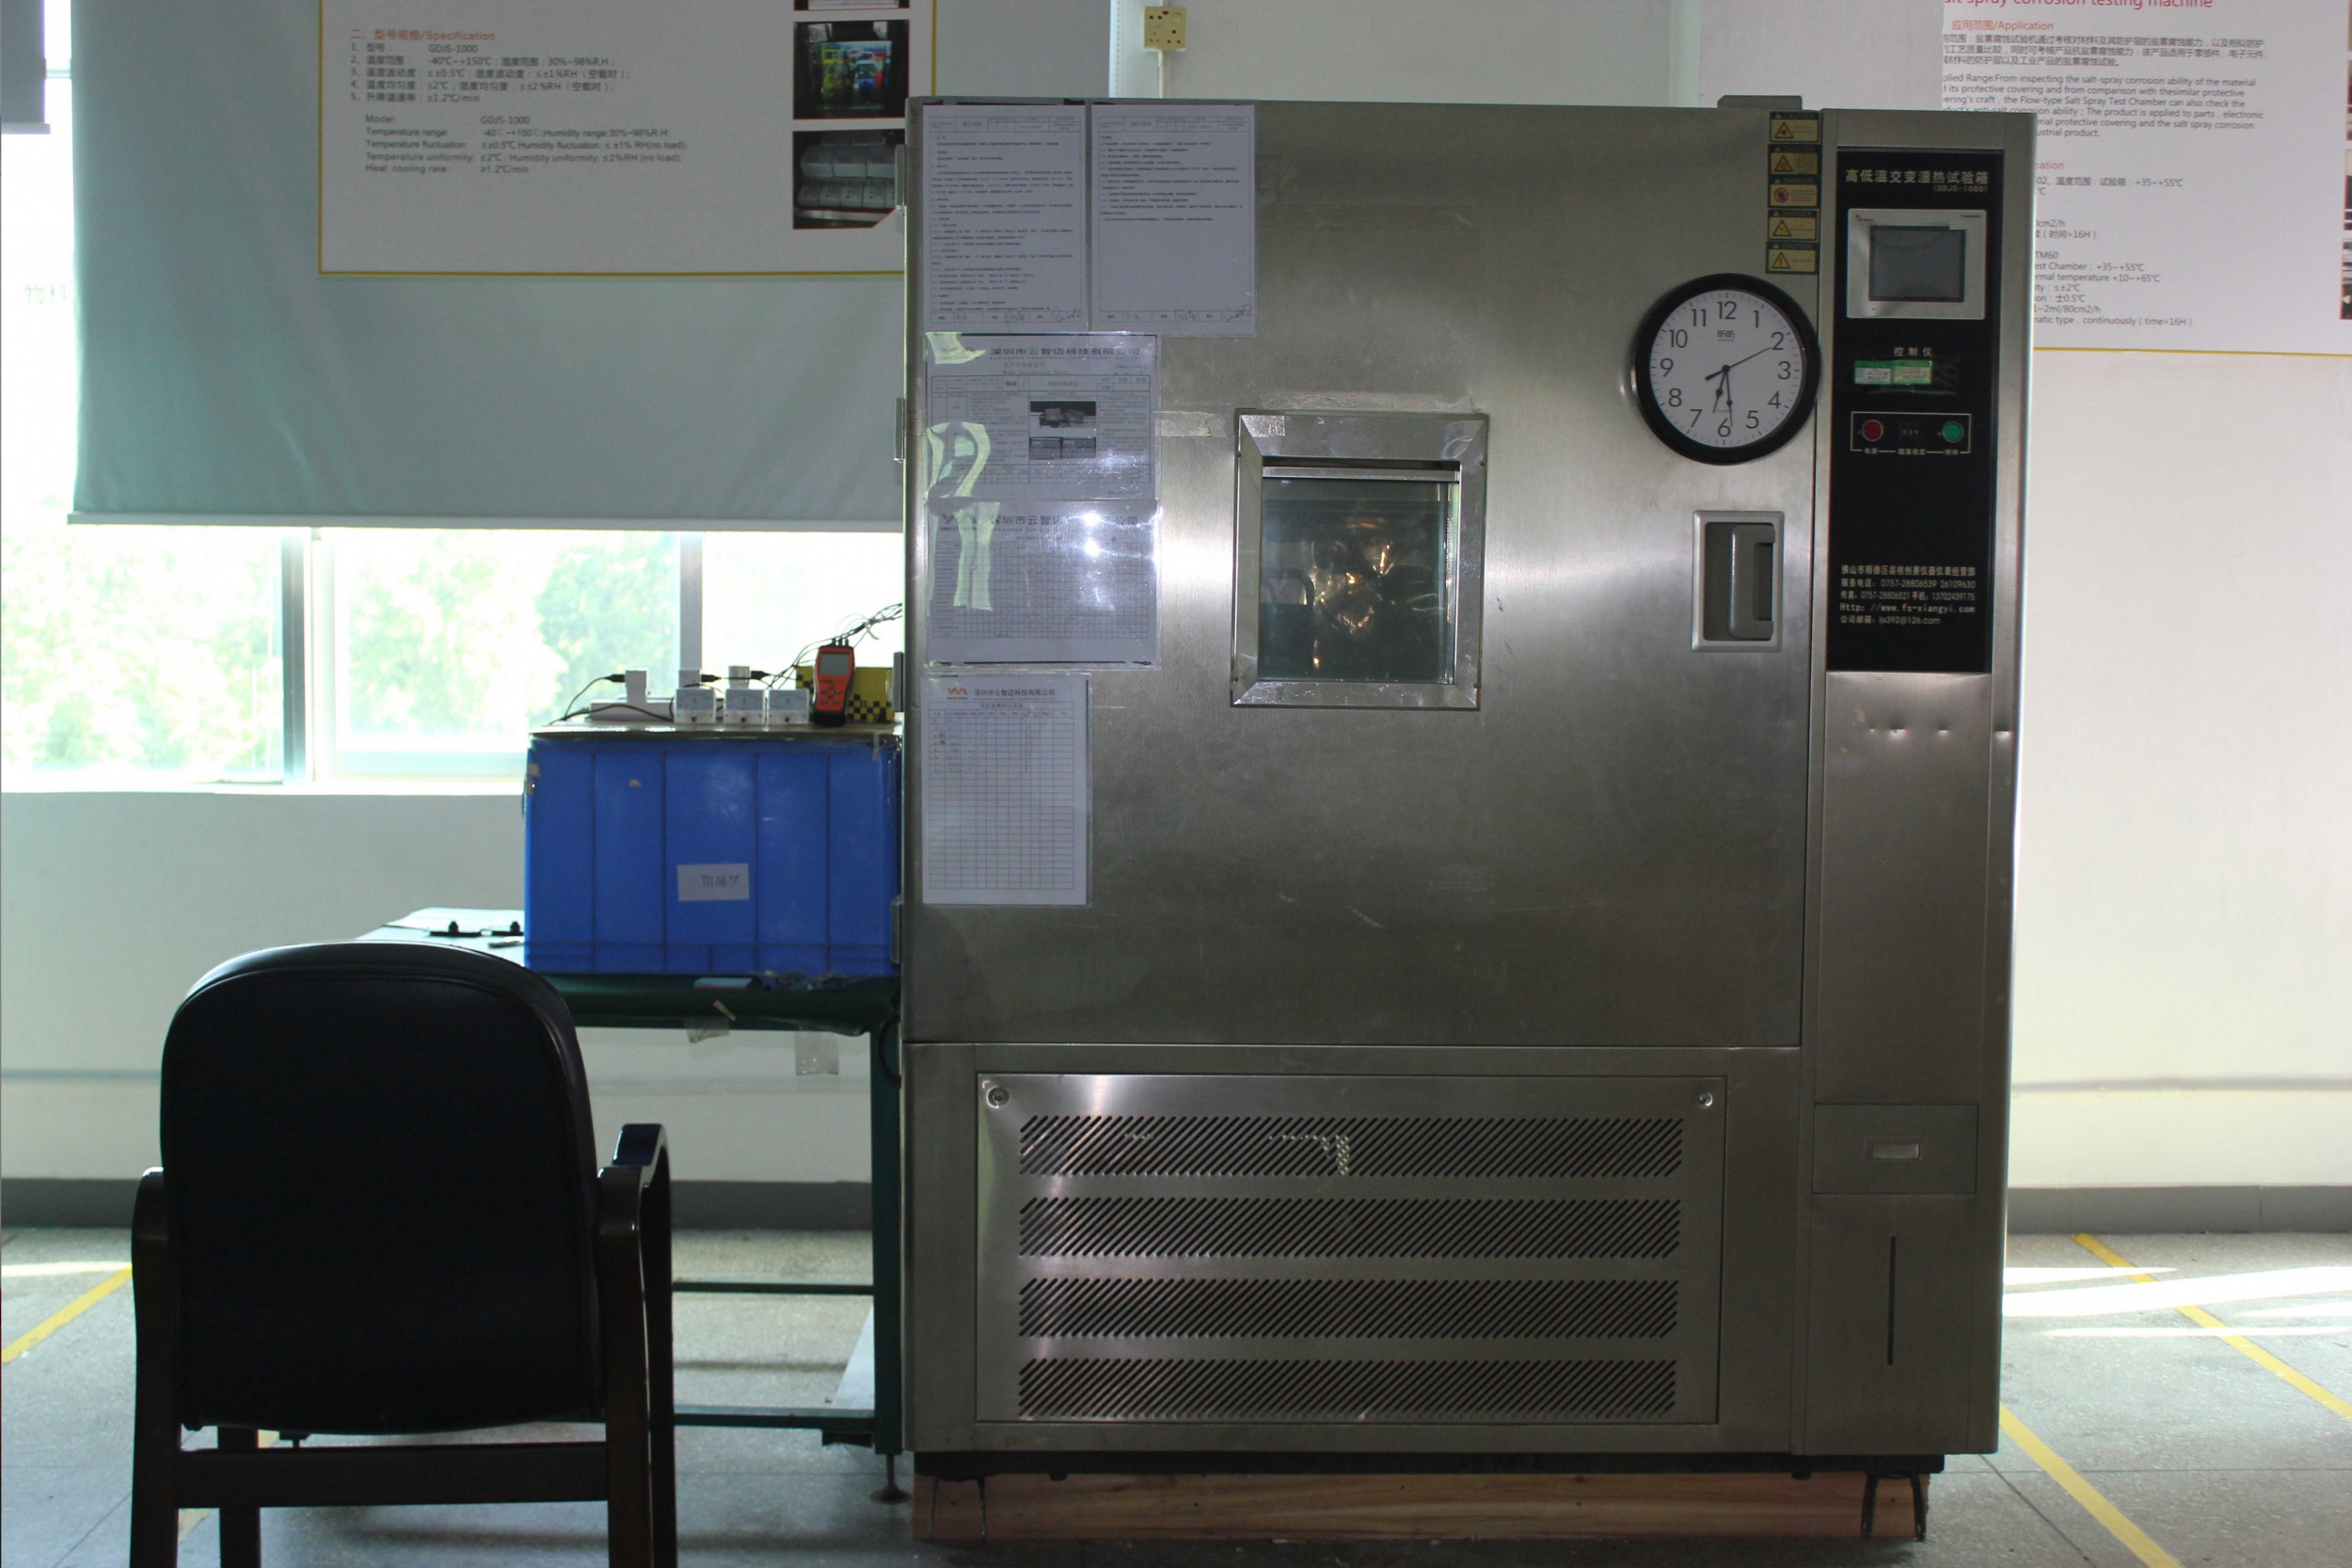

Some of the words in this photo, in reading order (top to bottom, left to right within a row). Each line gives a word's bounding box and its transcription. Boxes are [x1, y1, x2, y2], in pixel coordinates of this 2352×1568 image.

[2020, 75, 2063, 86] inspecting
[2066, 75, 2079, 84] the
[2082, 75, 2122, 86] salt-spray
[2167, 77, 2192, 87] ability
[2195, 77, 2203, 86] of
[2205, 78, 2218, 87] the
[2221, 78, 2256, 87] material
[1962, 85, 2005, 95] protective
[2008, 86, 2043, 96] covering
[2046, 86, 2062, 94] and
[2064, 86, 2084, 94] from
[2088, 87, 2136, 97] comparison
[2160, 87, 2200, 96] thesimilar
[2202, 88, 2244, 98] protective
[2020, 96, 2062, 106] Flow-type
[2083, 97, 2106, 106] Spray
[2128, 98, 2166, 106] Chamber
[2205, 99, 2229, 107] check
[2105, 108, 2137, 118] product
[2149, 109, 2180, 119] applied
[366, 127, 420, 137] Temperature
[2056, 119, 2097, 129] protective
[2100, 119, 2136, 129] covering
[2190, 121, 2212, 131] spray
[2065, 129, 2099, 138] product.
[366, 140, 420, 150] Temperature
[518, 141, 553, 150] Humidity
[366, 152, 423, 162] Temperature
[510, 154, 548, 164] Humidity
[392, 165, 425, 174] cooling
[1845, 169, 1989, 184] 高低温交变湿热试验箱
[2058, 274, 2109, 282] temperature
[1691, 309, 1707, 327] 11
[1717, 301, 1737, 320] 12
[1754, 310, 1759, 328] 1
[2083, 317, 2135, 326] continuously
[1669, 329, 1688, 348] 10
[1771, 332, 1784, 350] 2
[1661, 358, 1674, 377] 9
[1777, 361, 1790, 380] 3
[1668, 388, 1682, 407] 8
[1768, 390, 1781, 409] 4
[1690, 409, 1703, 428] 7
[1746, 411, 1759, 429] 5
[1717, 419, 1731, 437] 6
